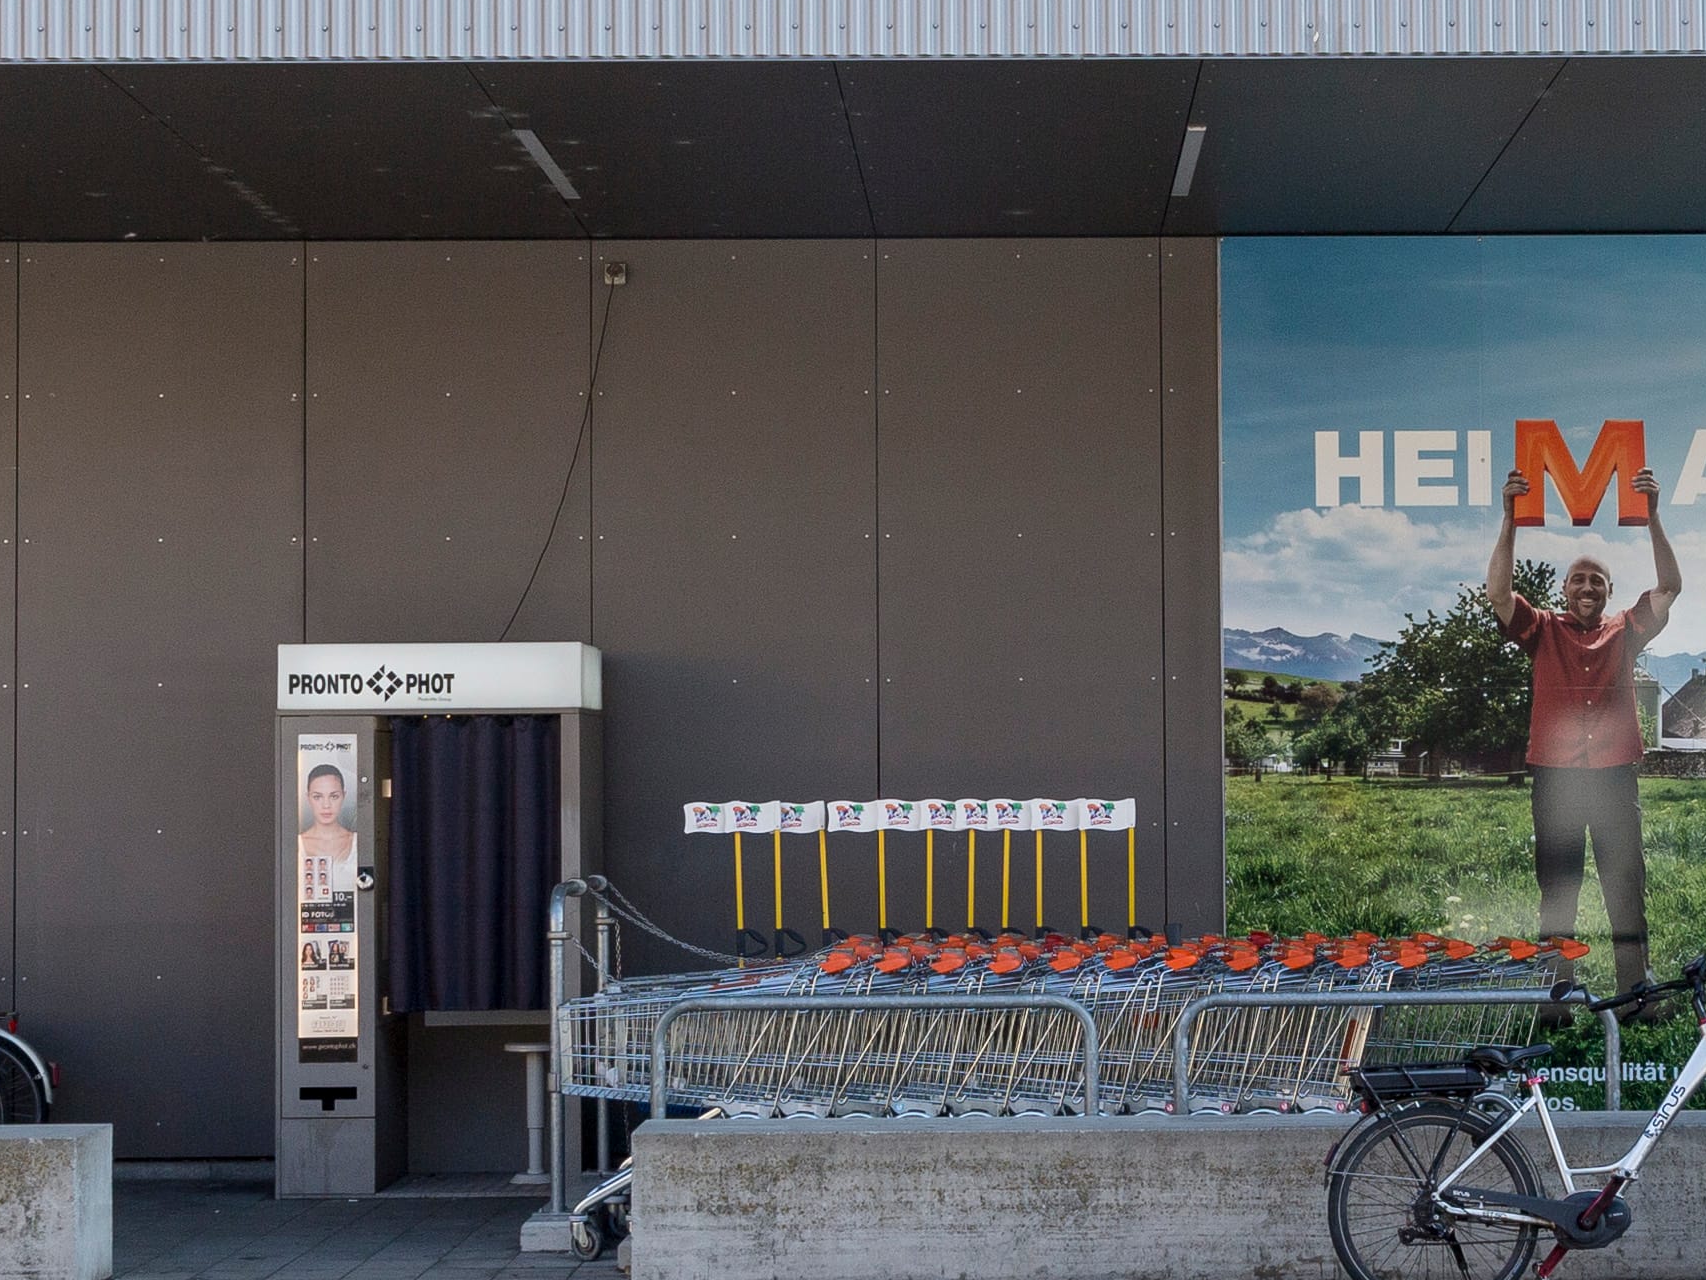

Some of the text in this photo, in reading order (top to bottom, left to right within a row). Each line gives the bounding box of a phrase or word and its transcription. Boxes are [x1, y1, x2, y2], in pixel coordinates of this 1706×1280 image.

[289, 672, 455, 695] PRONTO PHOT
[300, 743, 352, 751] PRONTO PHOT
[1498, 1061, 1668, 1087] eensqulität
